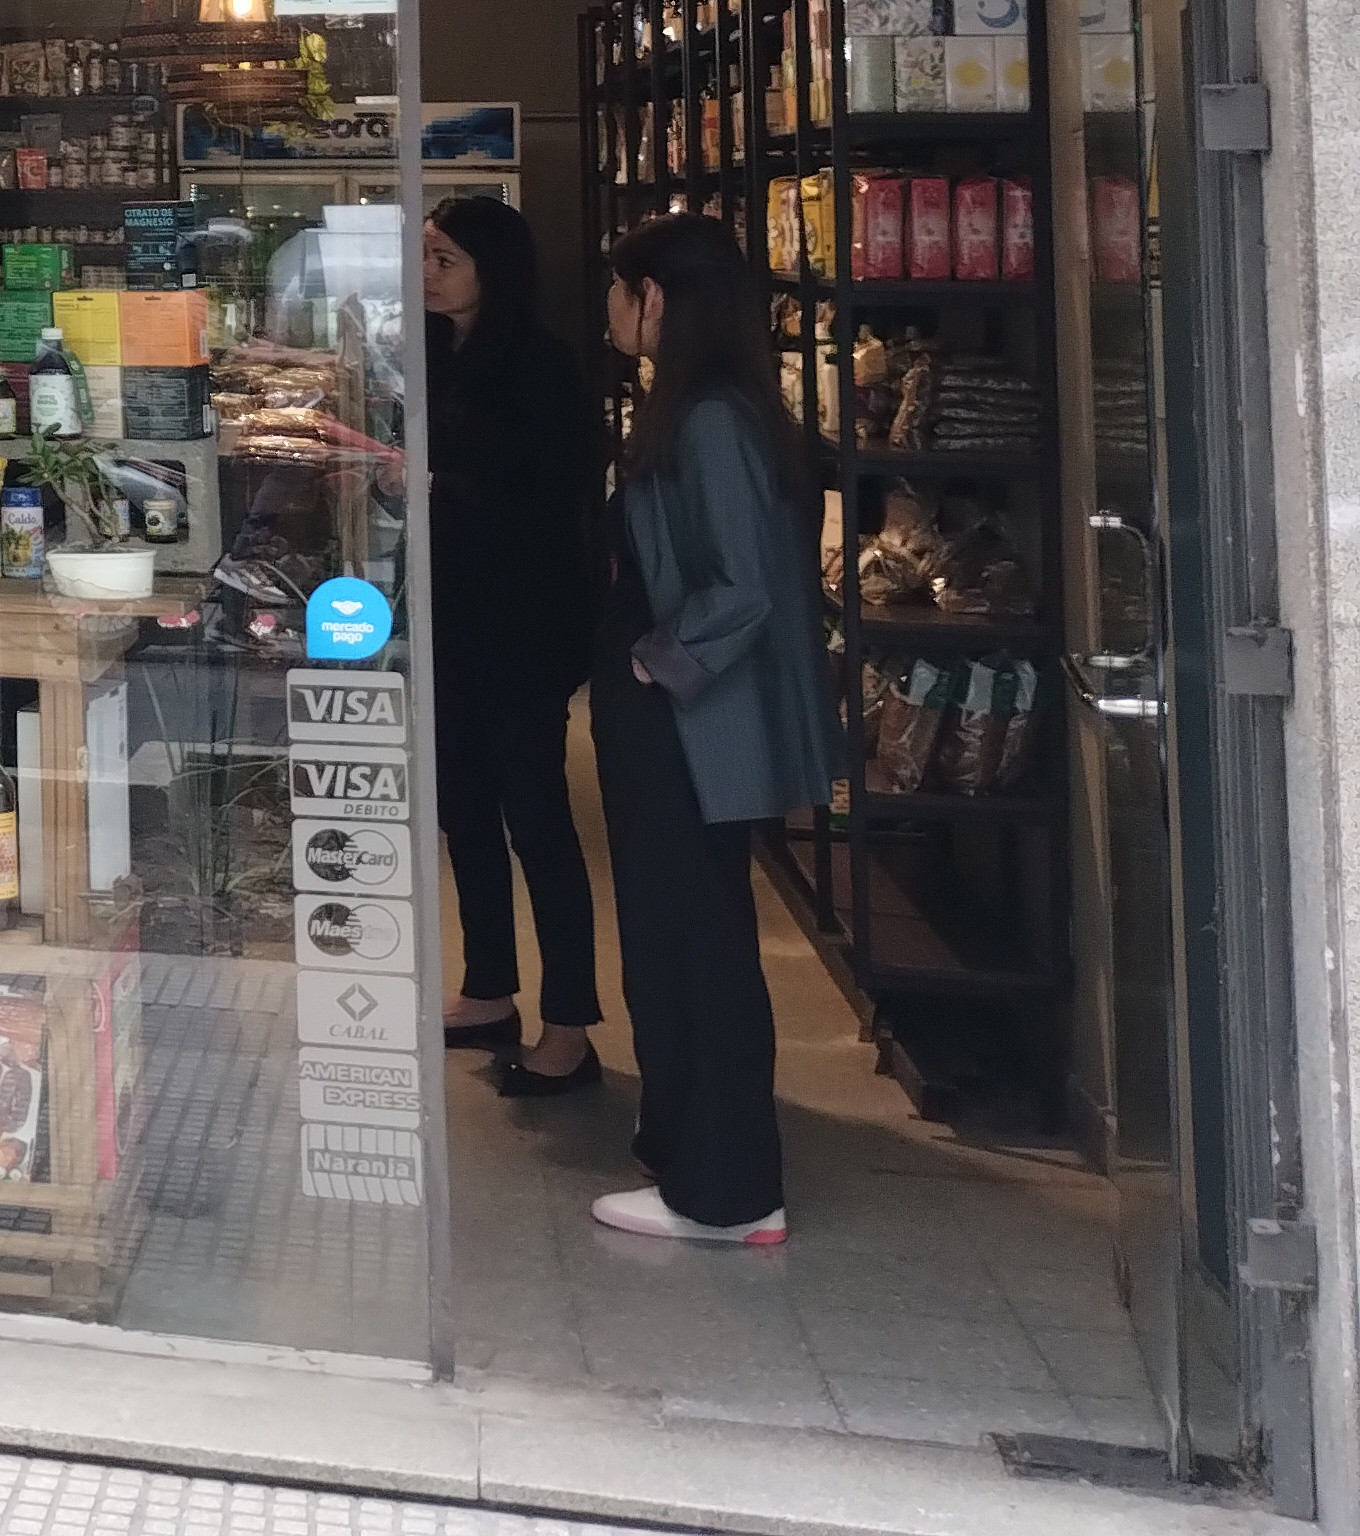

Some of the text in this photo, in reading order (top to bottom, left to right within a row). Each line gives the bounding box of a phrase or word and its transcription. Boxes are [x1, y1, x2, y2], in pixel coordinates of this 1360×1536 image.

[321, 621, 374, 634] mercado
[332, 633, 363, 644] pago
[294, 688, 397, 724] VISA
[297, 764, 400, 800] VISA
[343, 803, 399, 816] DEBITO
[307, 846, 393, 867] MasterCard
[329, 1023, 388, 1041] CABAL
[300, 1062, 411, 1087] AMERICAN
[325, 1087, 420, 1110] EXPRESS
[312, 1151, 410, 1178] Naranja
